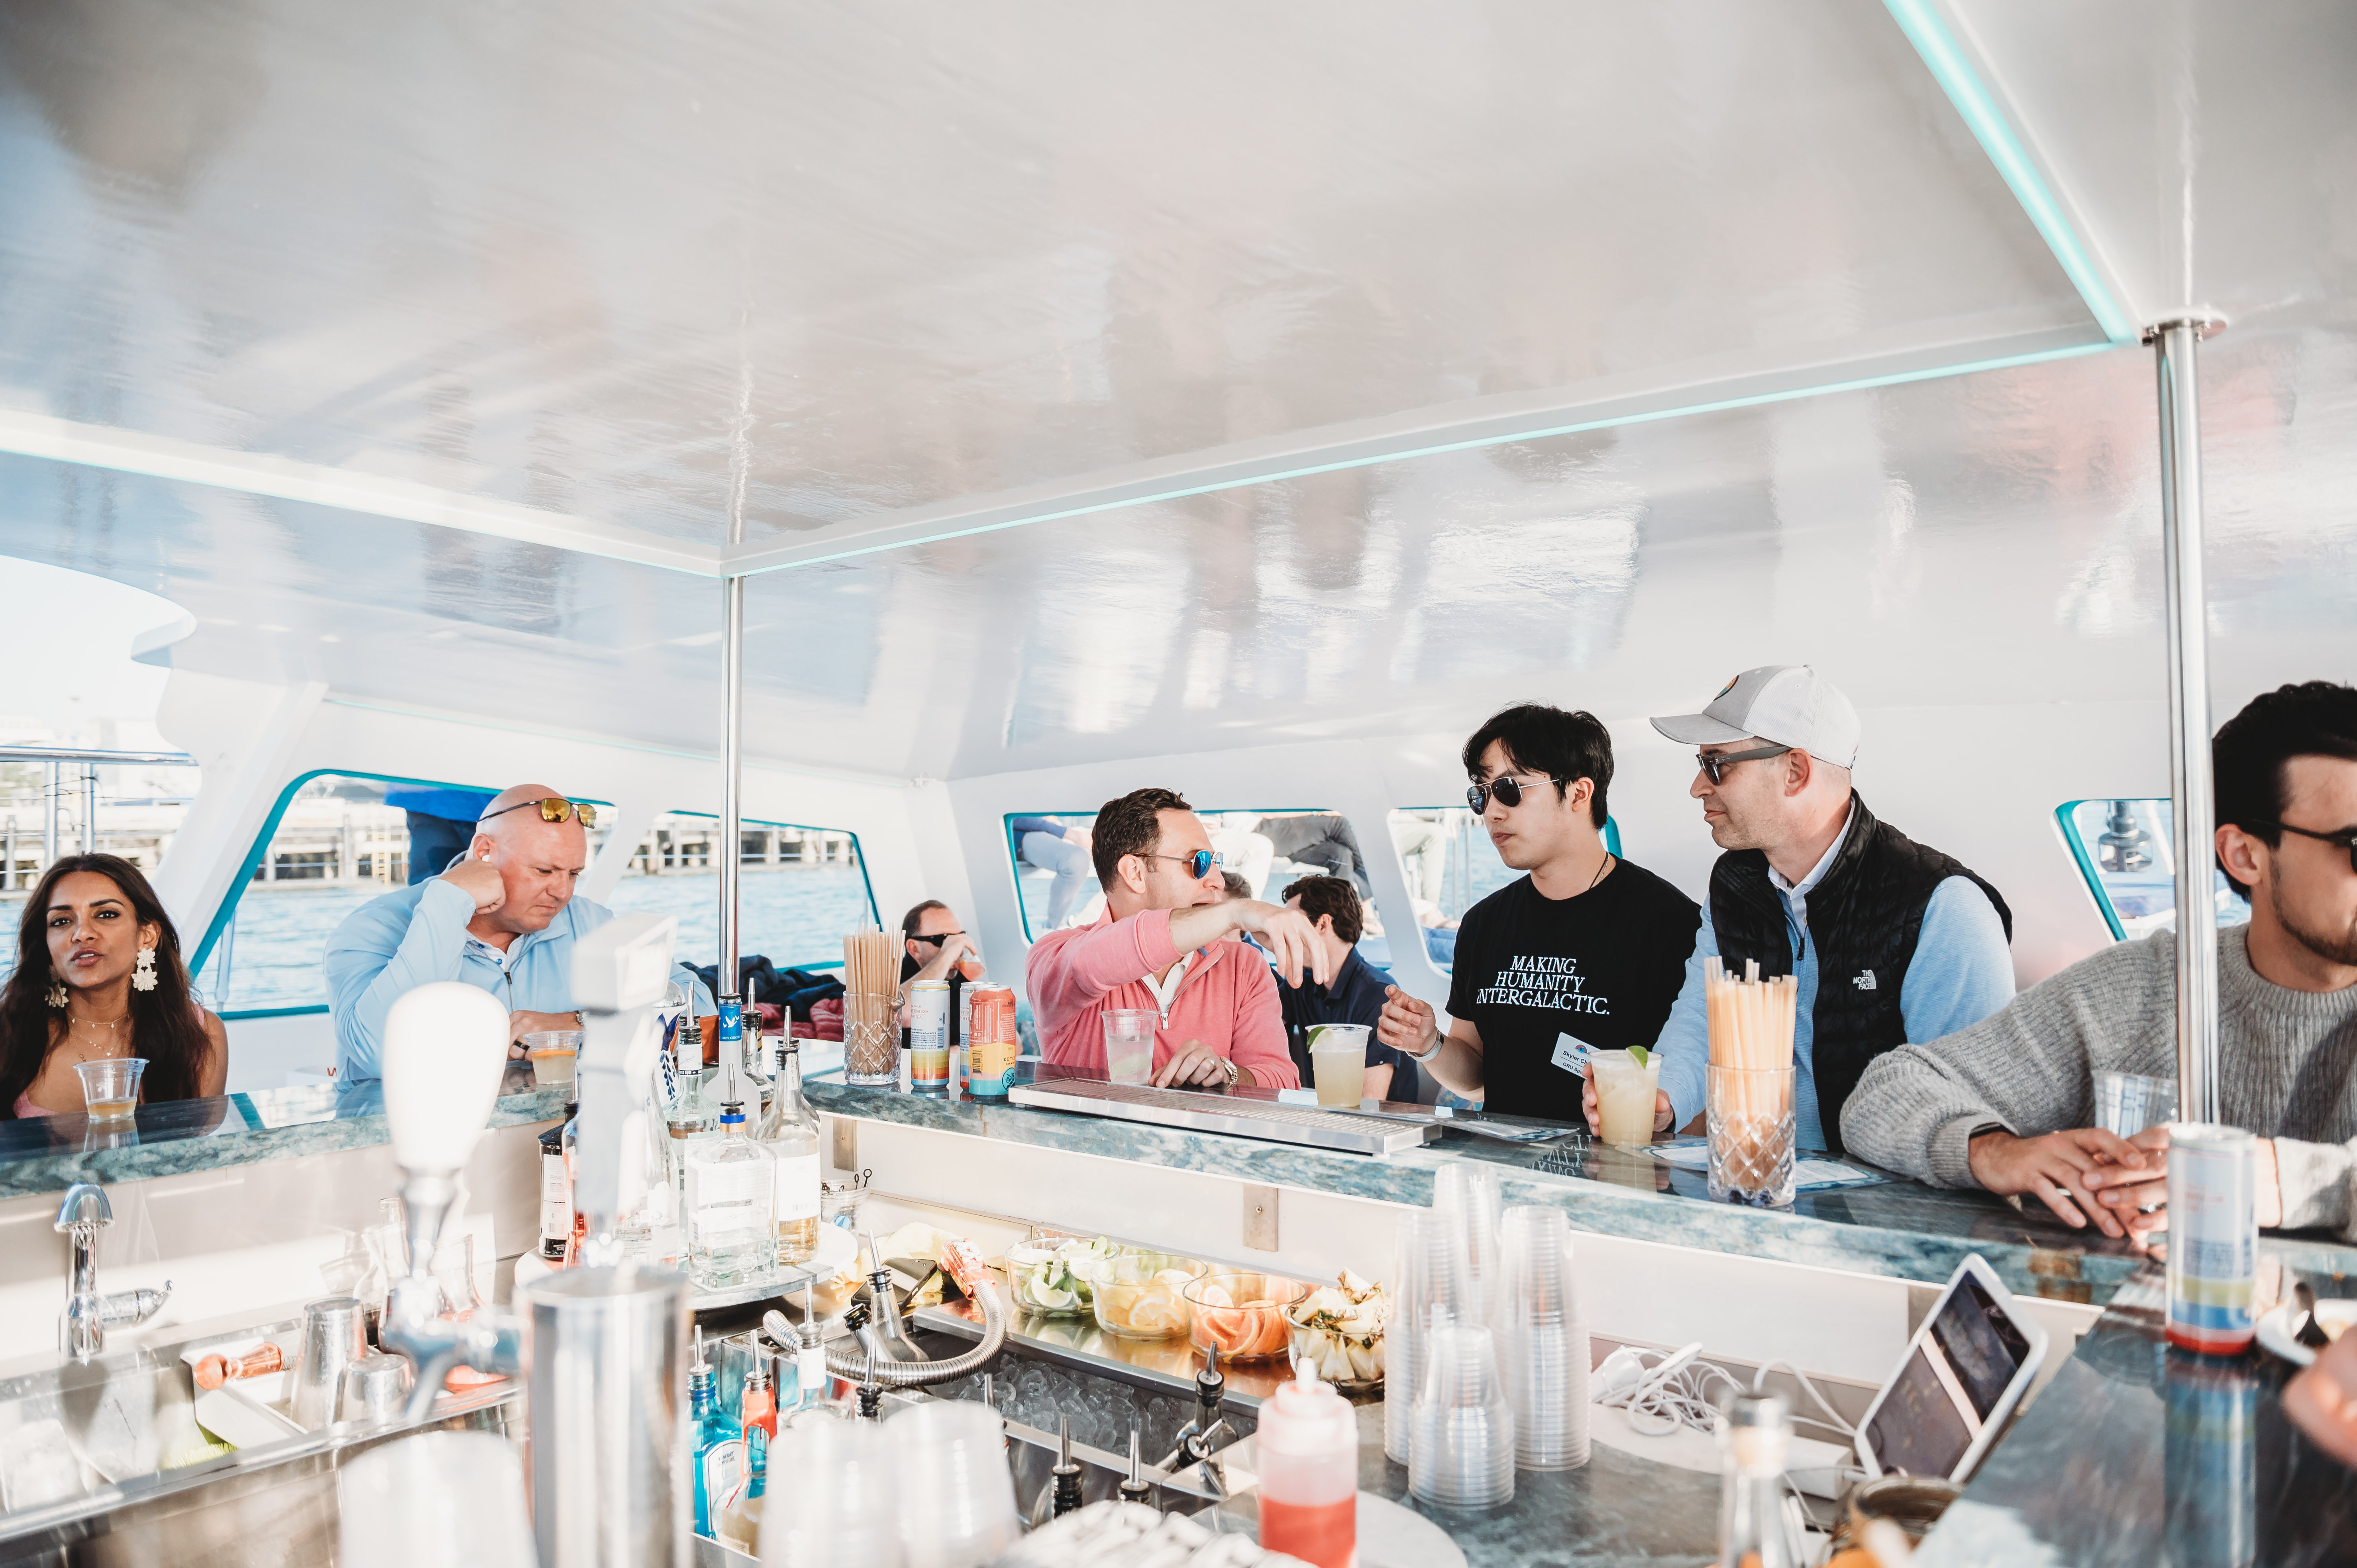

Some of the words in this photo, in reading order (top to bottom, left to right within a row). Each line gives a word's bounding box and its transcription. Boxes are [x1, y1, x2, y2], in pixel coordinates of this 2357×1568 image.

[1509, 955, 1577, 974] MAKING
[1495, 971, 1586, 993] HUMANITY
[1476, 988, 1610, 1015] INTERGALACTIC.
[1563, 1050, 1580, 1062] Skyler
[327, 1067, 336, 1077] W
